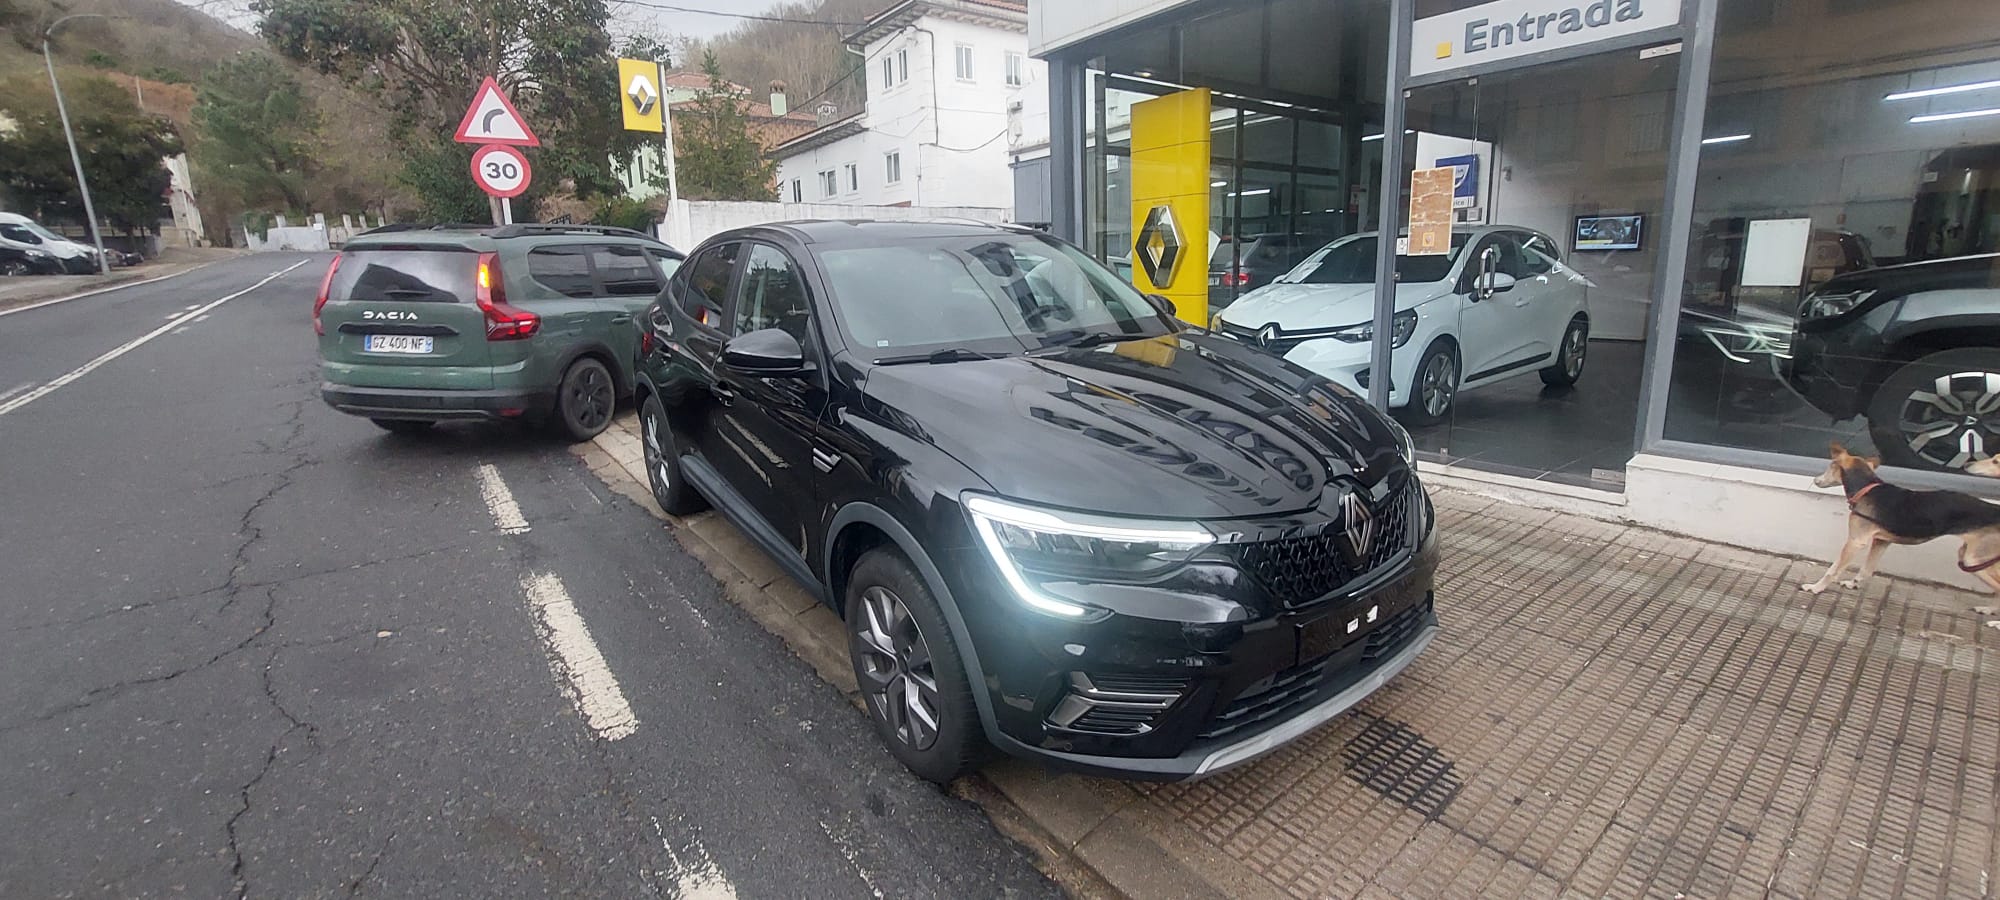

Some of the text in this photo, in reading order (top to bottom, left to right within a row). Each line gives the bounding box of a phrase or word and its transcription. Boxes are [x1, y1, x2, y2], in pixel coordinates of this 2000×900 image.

[1464, 0, 1643, 54] Entrada
[486, 162, 518, 180] 30
[363, 311, 418, 320] DACIA
